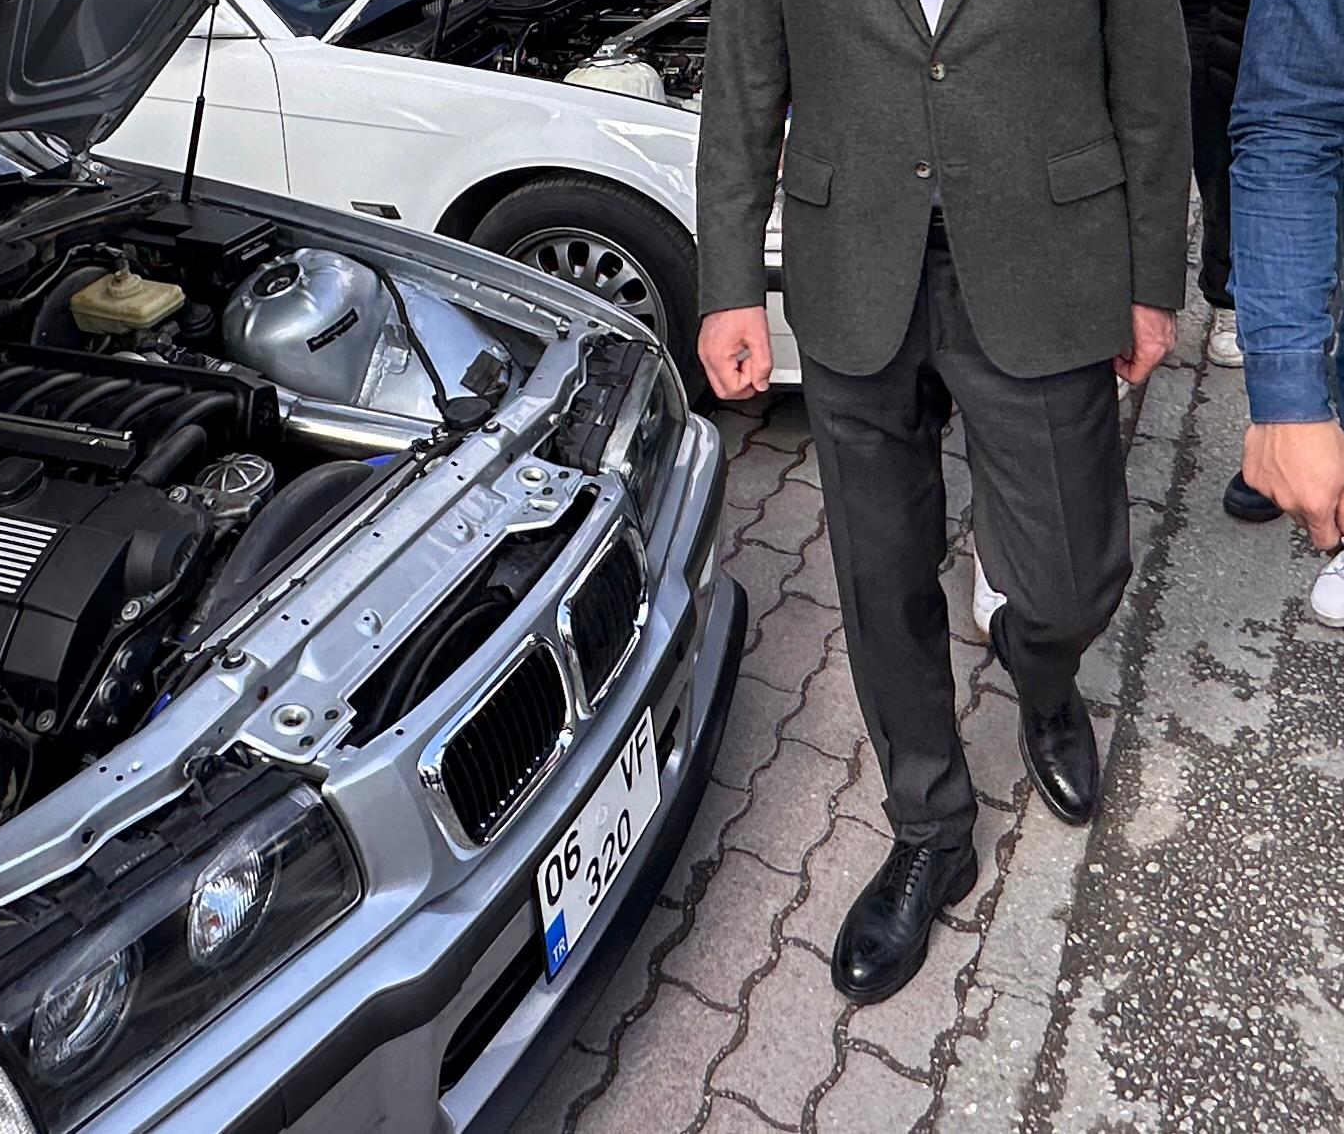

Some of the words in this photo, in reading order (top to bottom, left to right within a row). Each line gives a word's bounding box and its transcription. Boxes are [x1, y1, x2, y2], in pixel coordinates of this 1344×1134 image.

[544, 829, 582, 906] 06
[619, 718, 649, 793] VF
[585, 809, 632, 907] 320
[552, 936, 567, 963] TR
